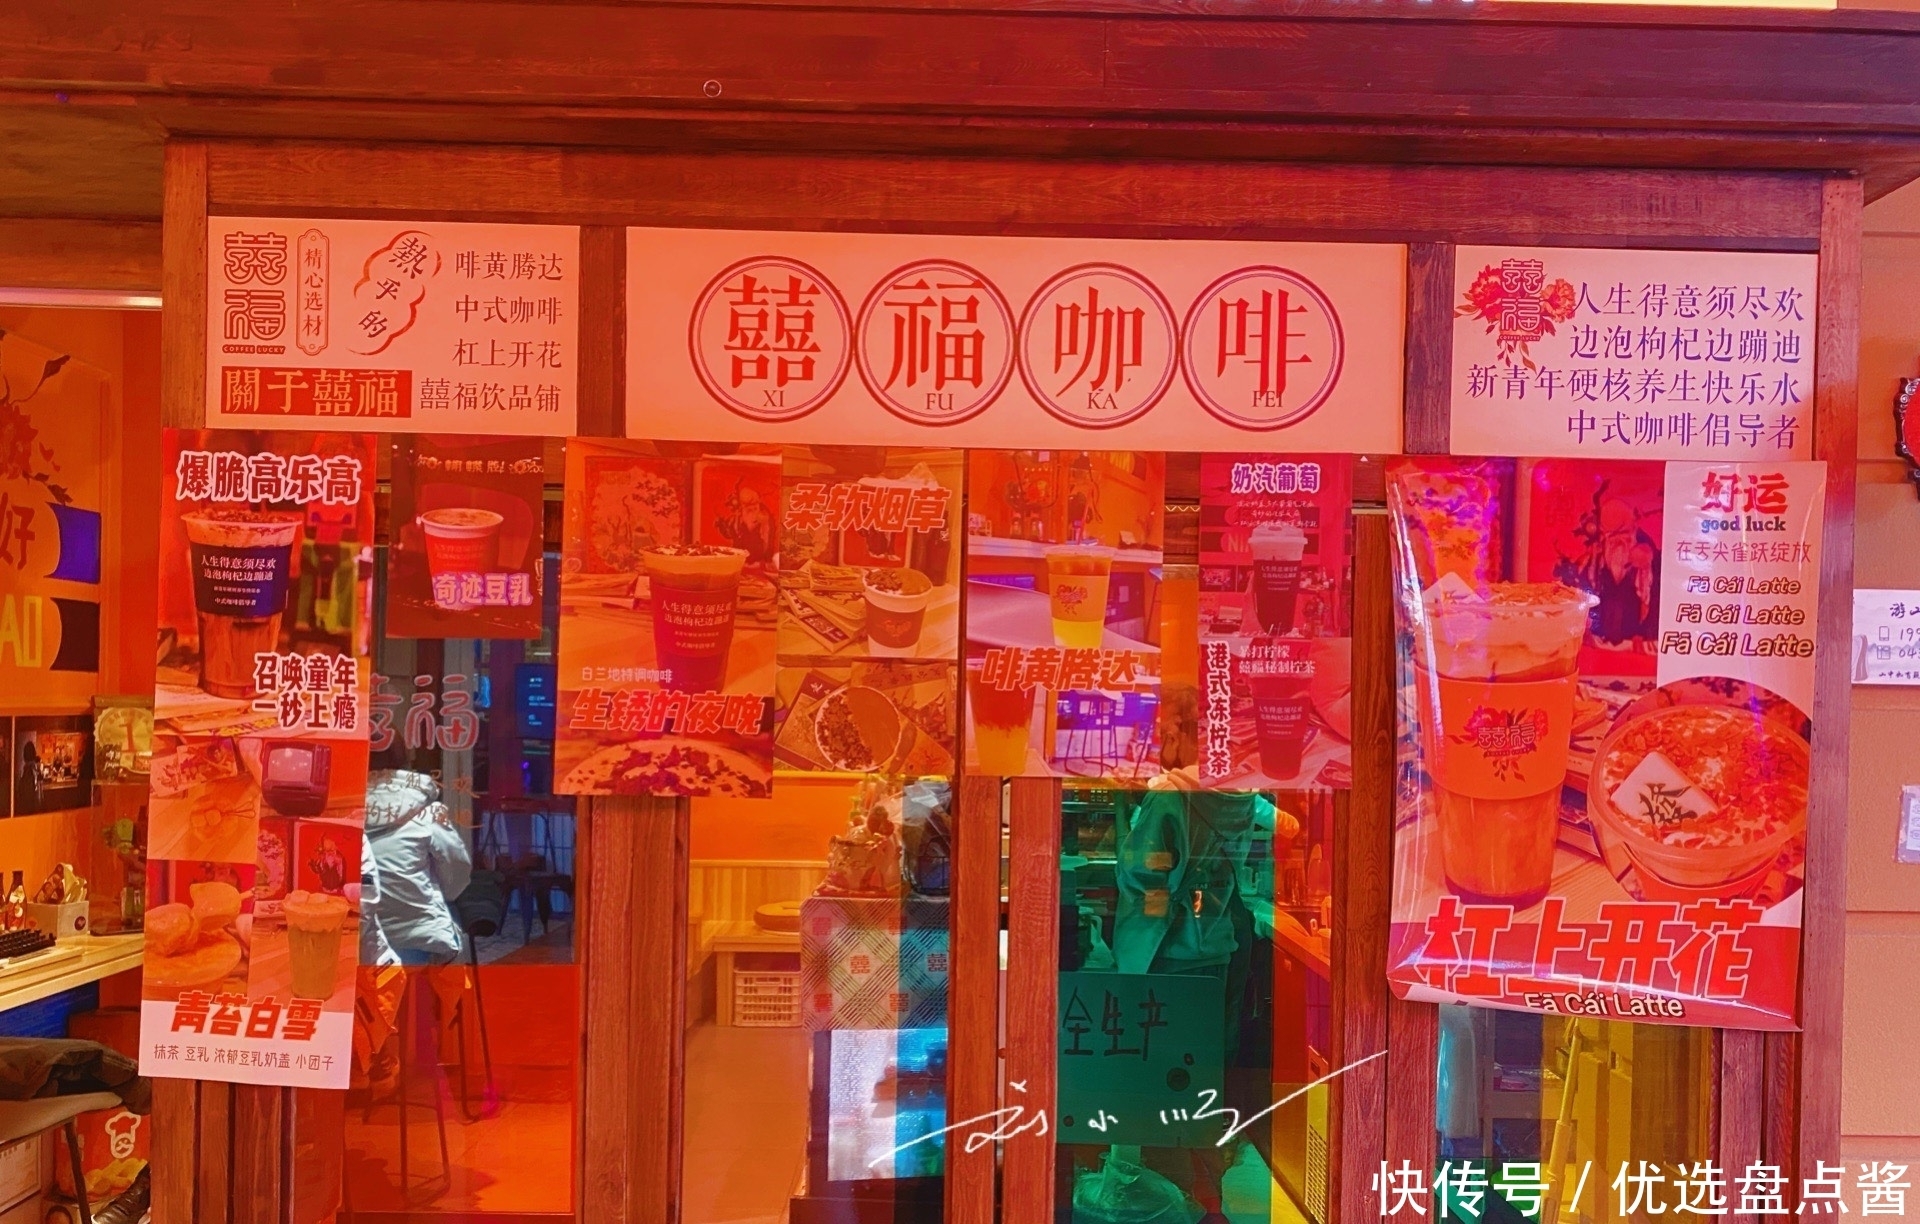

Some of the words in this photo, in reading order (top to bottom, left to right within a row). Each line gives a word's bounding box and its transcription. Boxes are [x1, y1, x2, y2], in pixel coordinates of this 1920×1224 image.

[455, 251, 564, 281] 啡黄腾达
[302, 247, 324, 337] 精心选材
[357, 237, 428, 339] 熱乎的
[1574, 281, 1804, 322] 人生得意须尽欢
[455, 294, 564, 325] 中式咖啡
[223, 345, 254, 354] COFFEE
[257, 346, 286, 354] LUCKY
[452, 338, 563, 369] 杠上开花
[1569, 324, 1801, 364] 边泡枸杞边蹦迪
[225, 368, 400, 417] 關于囍福
[420, 377, 562, 413] 囍福饮品铺
[763, 389, 785, 408] XI
[925, 392, 955, 411] FU
[1252, 390, 1284, 408] FEI
[1465, 364, 1802, 405] 新青年硬核养生快乐水
[1569, 408, 1800, 450] 中式咖啡倡导者
[176, 450, 361, 504] 爆脆高乐高
[1231, 463, 1320, 493] 奶汽葡萄
[1701, 472, 1789, 514] 好运
[783, 482, 952, 533] 柔软烟草
[1701, 515, 1740, 533] good
[1746, 515, 1786, 531] luck
[201, 555, 277, 570] 人生得意须尽欢
[433, 573, 534, 605] 奇迹豆乳
[1713, 576, 1744, 594] Cái
[1746, 577, 1802, 594] Latte
[1705, 604, 1741, 624] Cái
[1743, 605, 1805, 625] Latte
[1697, 632, 1738, 656] Cái
[1741, 633, 1814, 657] Latte
[254, 652, 358, 693] 召唤童年
[980, 646, 1140, 692] 啡黄腾达
[253, 693, 358, 732] 一秒上瘾
[569, 687, 765, 735] 生锈的夜晚
[1207, 641, 1231, 777] 港式冻柠茶
[1415, 897, 1766, 1000] 杠上开花
[171, 990, 324, 1042] 青苔白雪
[1614, 993, 1686, 1018] Latte
[153, 1043, 179, 1061] 抹茶
[185, 1046, 210, 1063] 豆乳
[213, 1047, 291, 1069] 浓郁豆乳奶盖
[295, 1053, 334, 1071] 小团子
